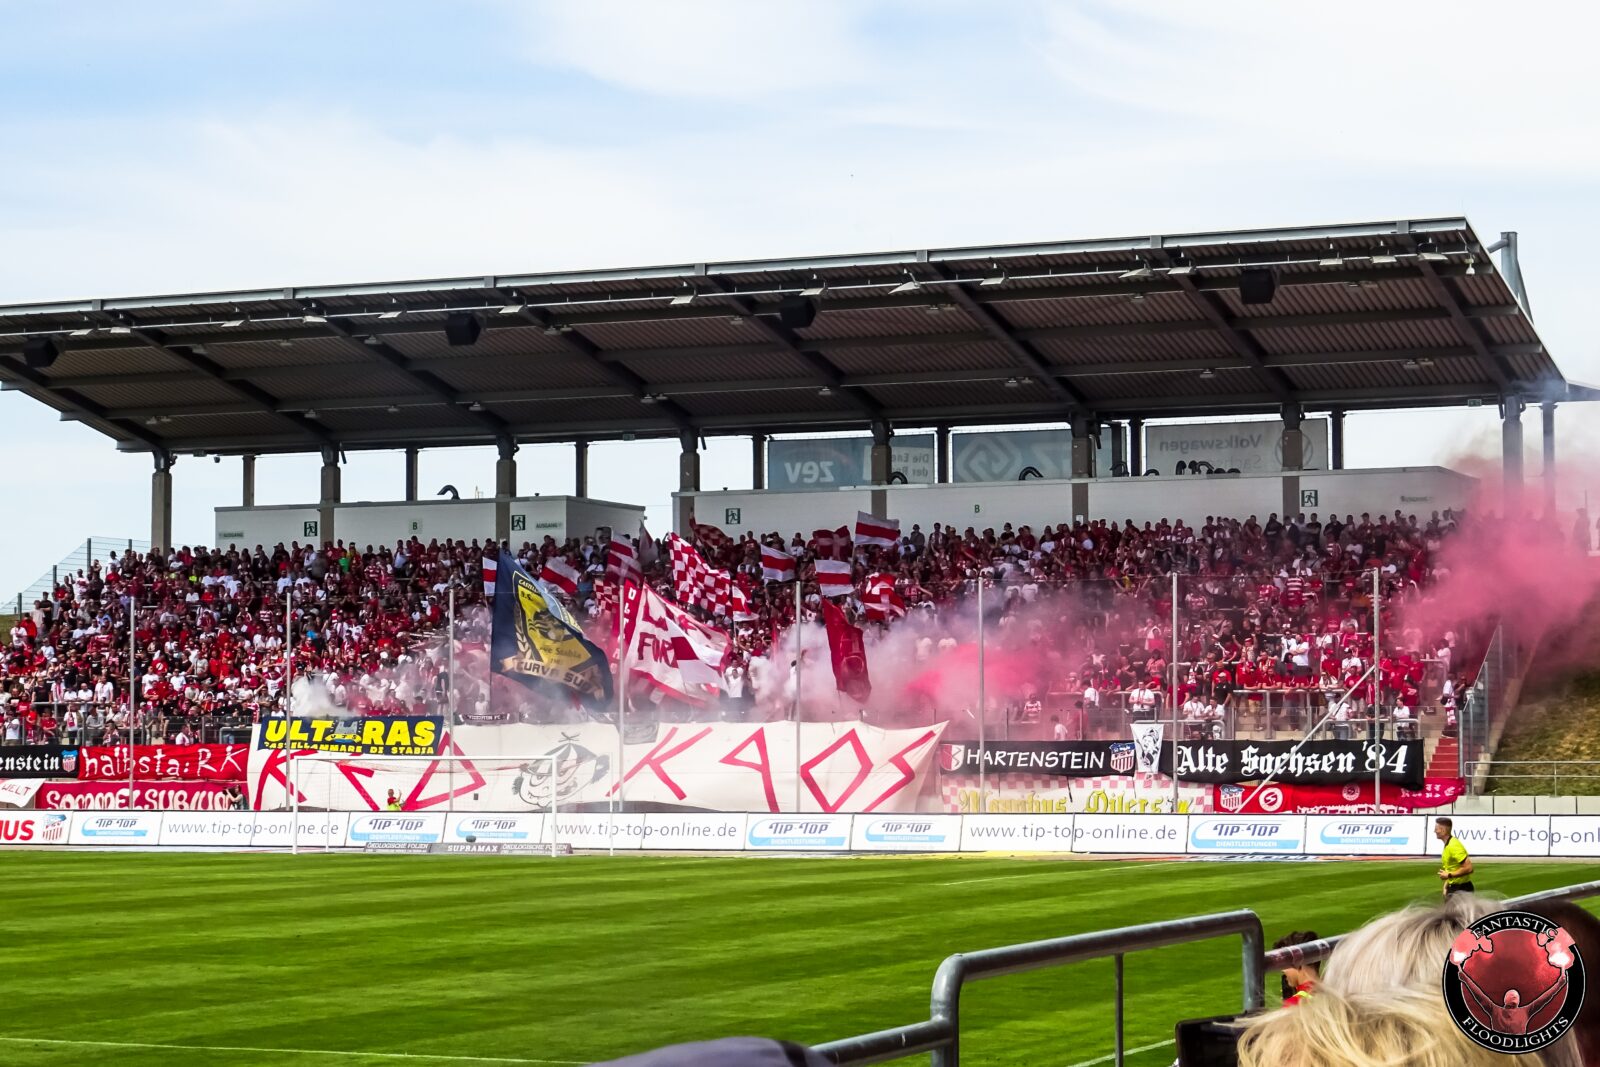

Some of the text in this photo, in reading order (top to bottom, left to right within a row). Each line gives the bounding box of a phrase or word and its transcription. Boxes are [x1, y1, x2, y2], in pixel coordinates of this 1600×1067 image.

[974, 504, 980, 513] B
[412, 522, 418, 530] B
[391, 747, 435, 755] STABIA
[967, 749, 1105, 769] HARTENSTEIN
[1177, 745, 1228, 776] Alte
[1240, 745, 1355, 777] Sachsen
[168, 820, 339, 836] www.tip-top-onlne.de
[970, 823, 1177, 842] www.tip-top-online.de
[1453, 826, 1600, 847] ww.tip-top-onl
[447, 844, 499, 853] SUPRAMAX
